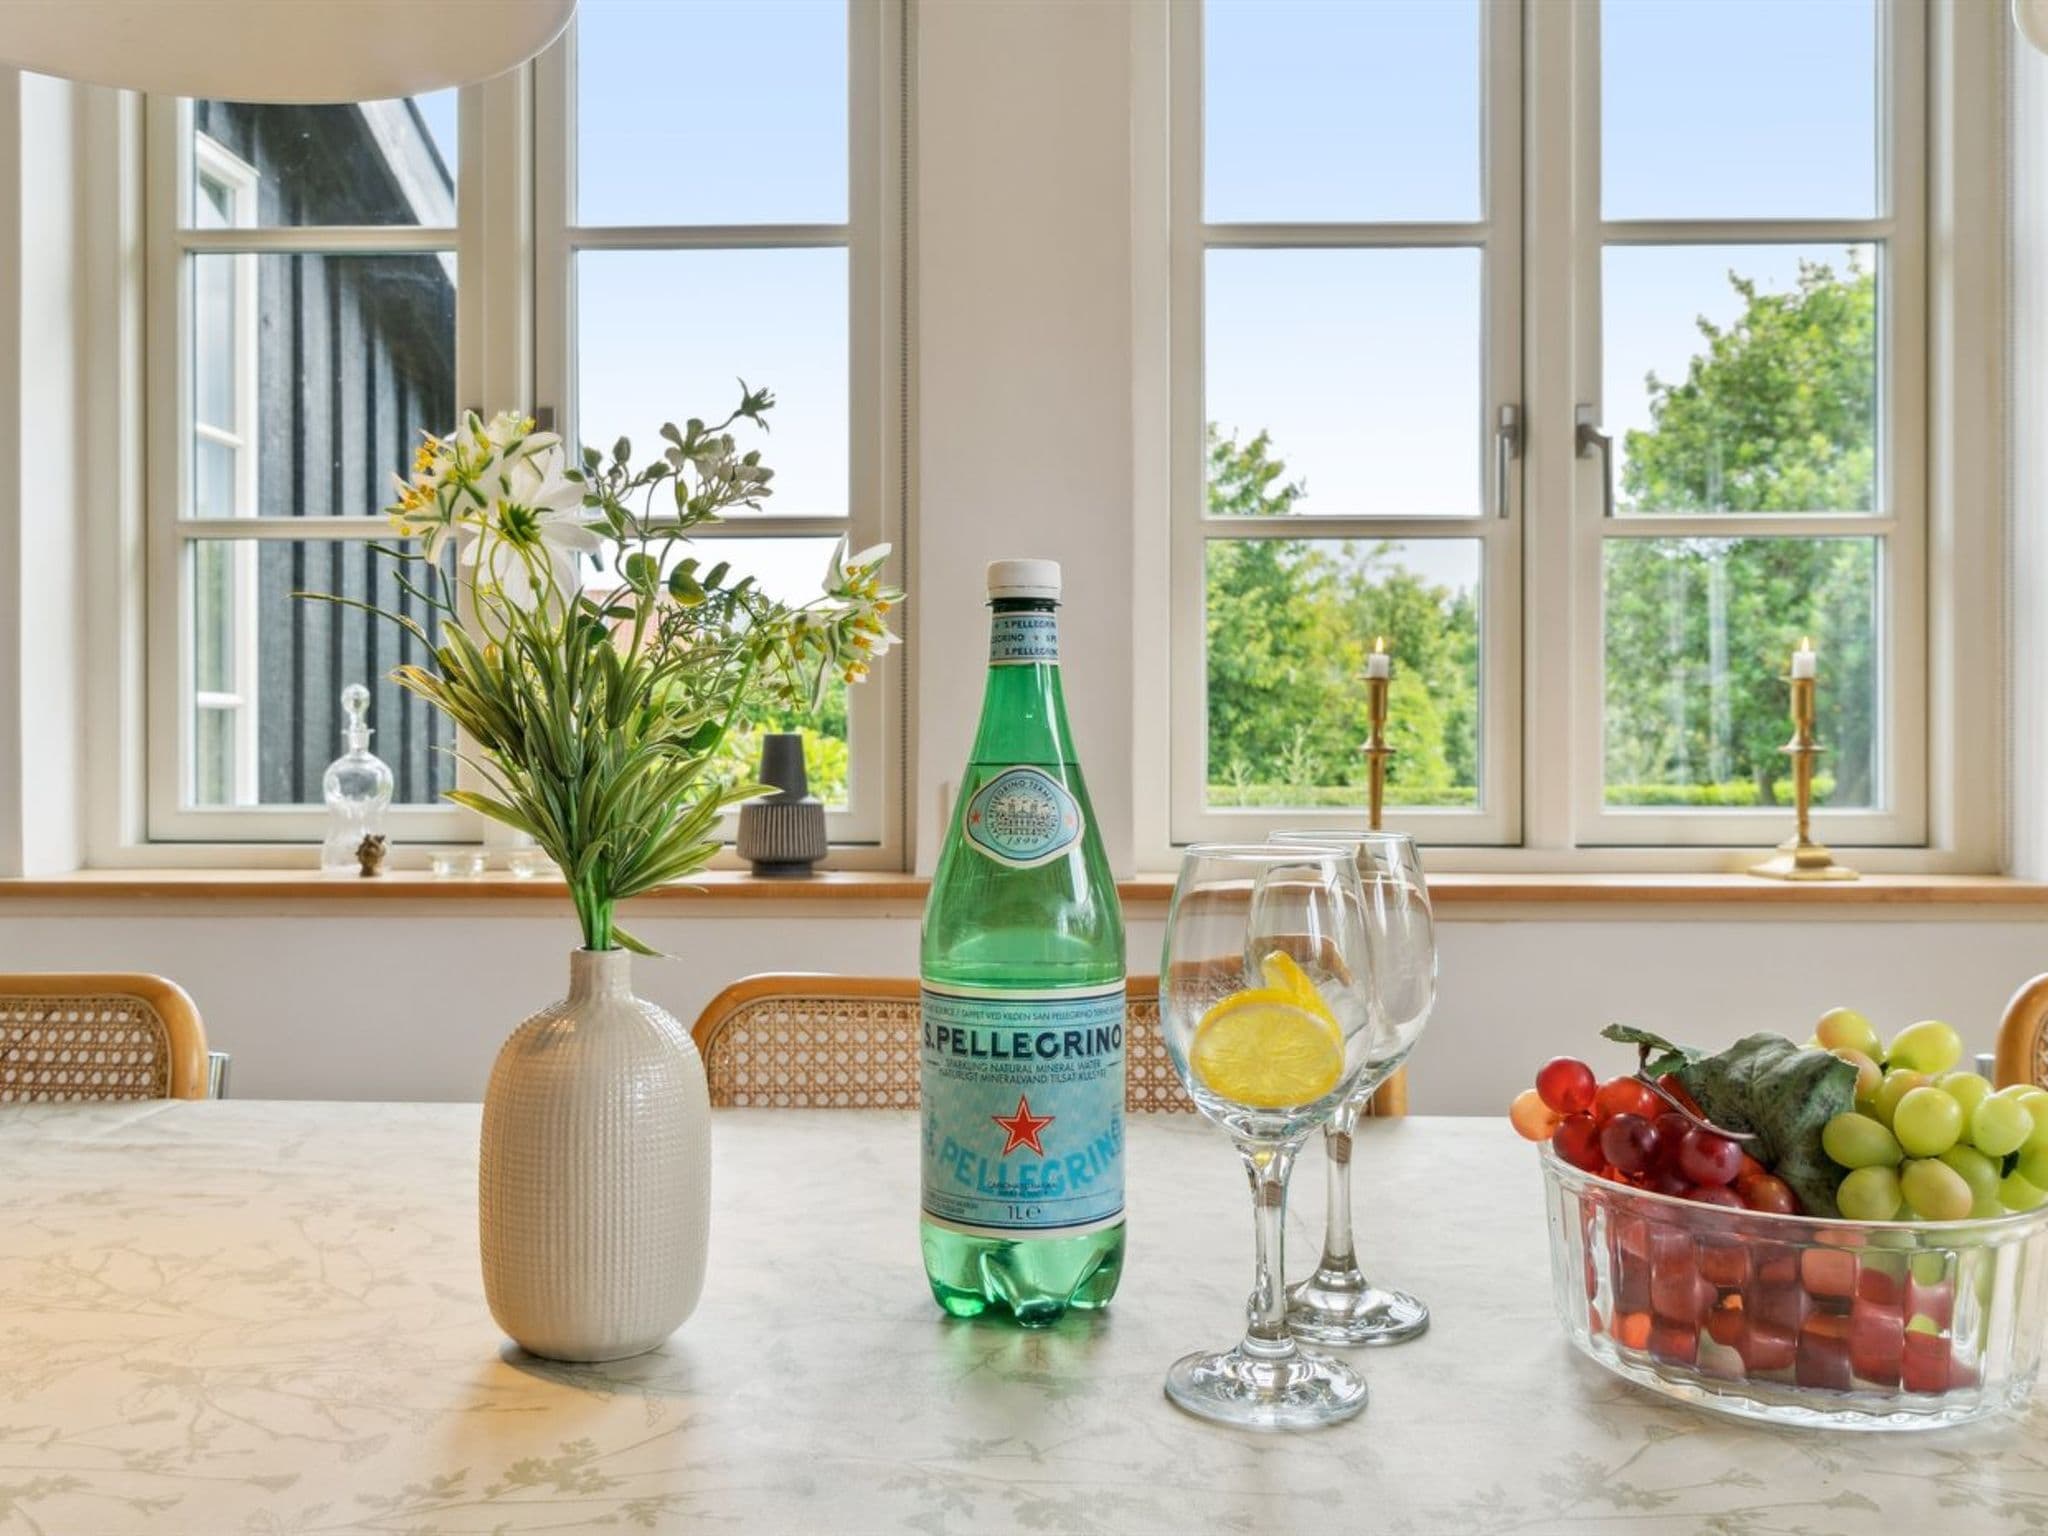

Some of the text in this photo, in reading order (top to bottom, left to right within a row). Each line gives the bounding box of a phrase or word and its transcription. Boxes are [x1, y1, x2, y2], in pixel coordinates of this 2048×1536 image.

[924, 1022, 1122, 1058] S.PELLEGRINO
[991, 1063, 1033, 1073] NATURAL
[1036, 1062, 1076, 1073] MINERAL
[1078, 1058, 1102, 1070] WATER
